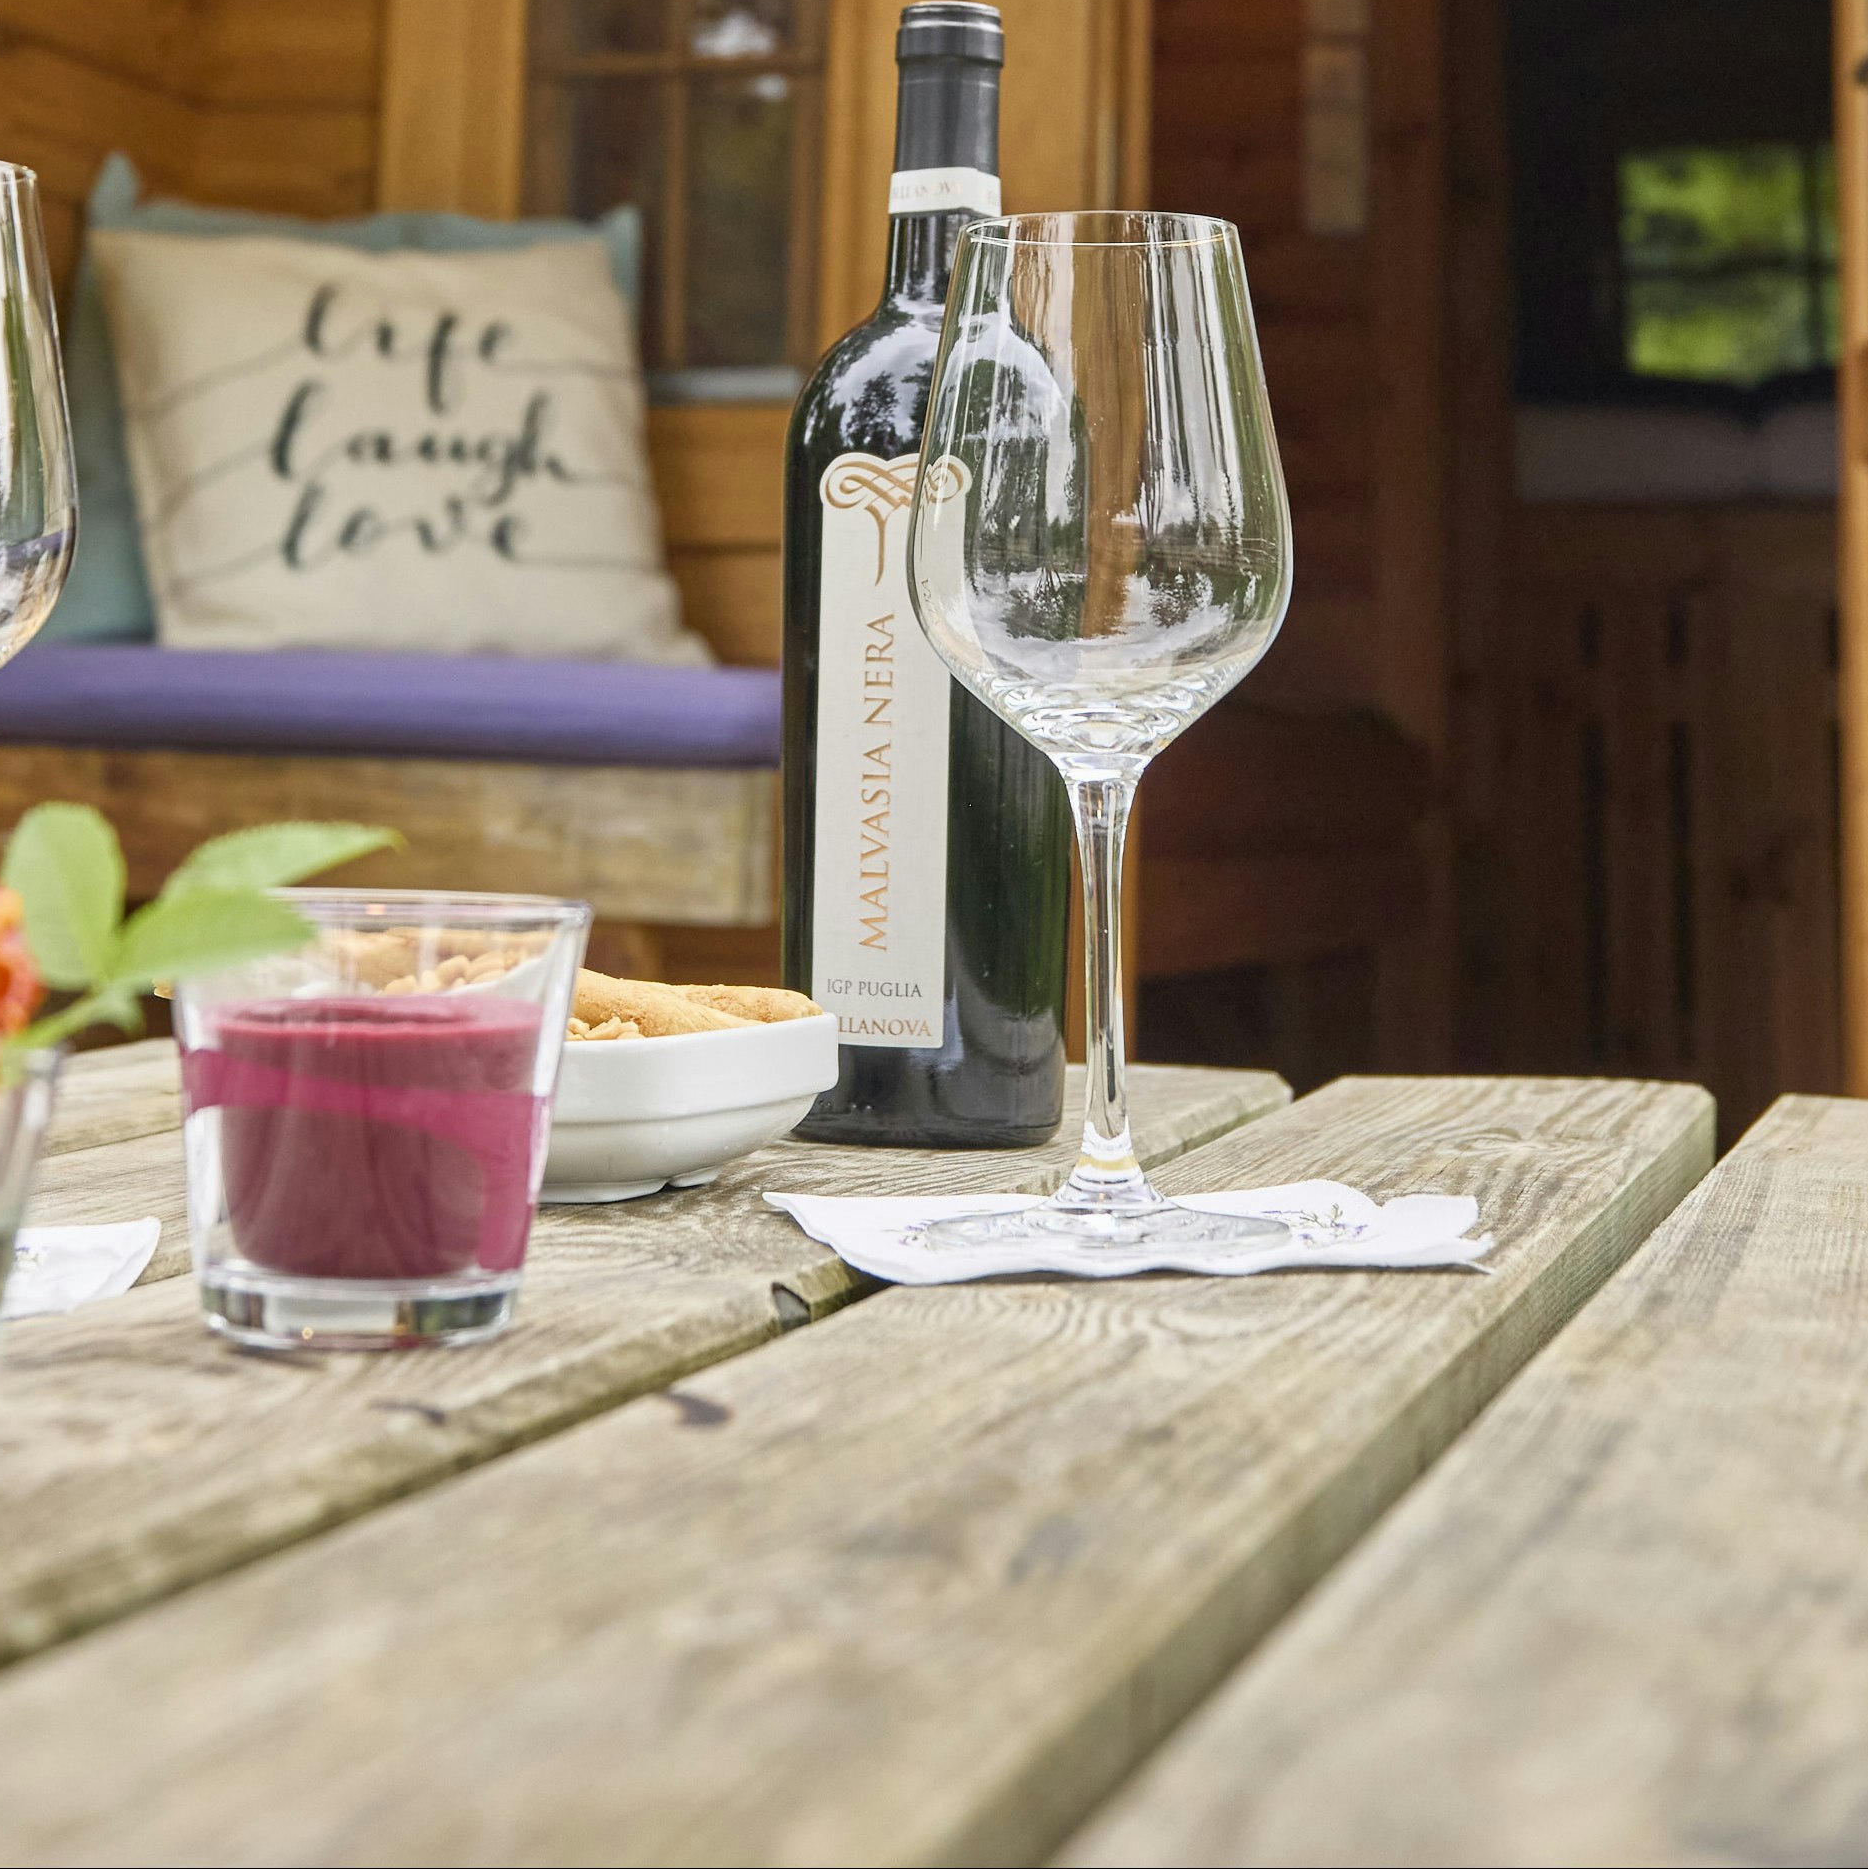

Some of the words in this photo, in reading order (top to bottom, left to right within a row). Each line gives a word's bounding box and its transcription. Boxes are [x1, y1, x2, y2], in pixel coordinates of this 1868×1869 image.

[863, 612, 895, 728] NERA
[858, 742, 893, 952] MALVASIA
[827, 978, 853, 995] IGP
[858, 980, 923, 998] PUGLIA
[836, 1015, 933, 1037] LLANOVA
